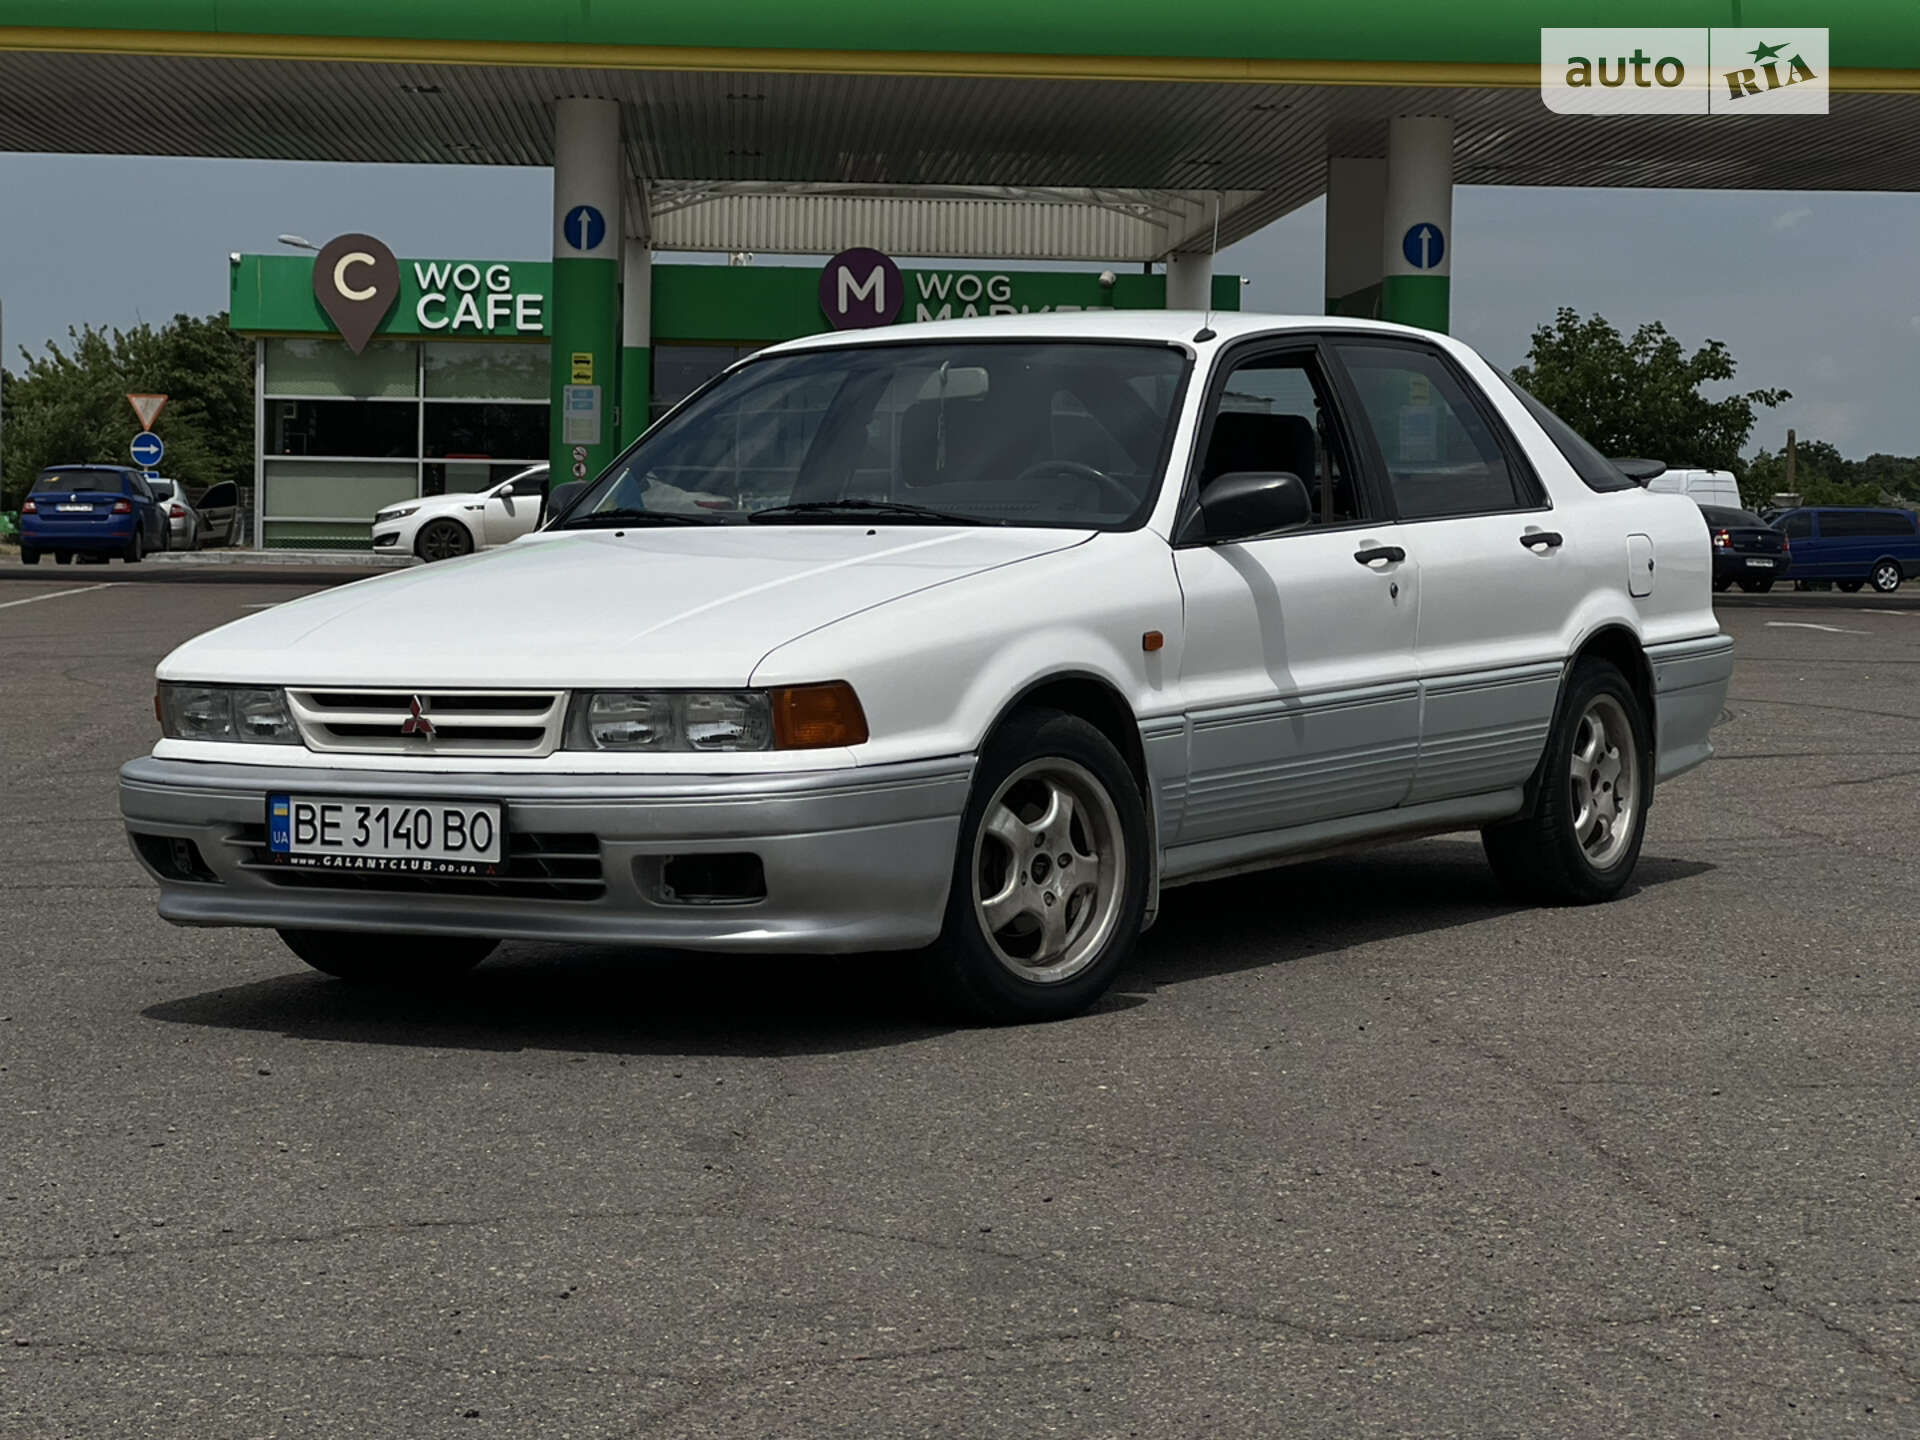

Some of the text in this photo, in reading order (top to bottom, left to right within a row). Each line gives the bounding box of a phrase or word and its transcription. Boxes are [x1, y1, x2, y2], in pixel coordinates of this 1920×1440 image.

[333, 252, 377, 301] C
[414, 262, 511, 291] WOG
[837, 265, 885, 314] M
[916, 273, 1011, 302] WOG
[416, 293, 544, 330] CAFE
[272, 831, 289, 845] UA
[295, 803, 493, 853] BE 3140 BO
